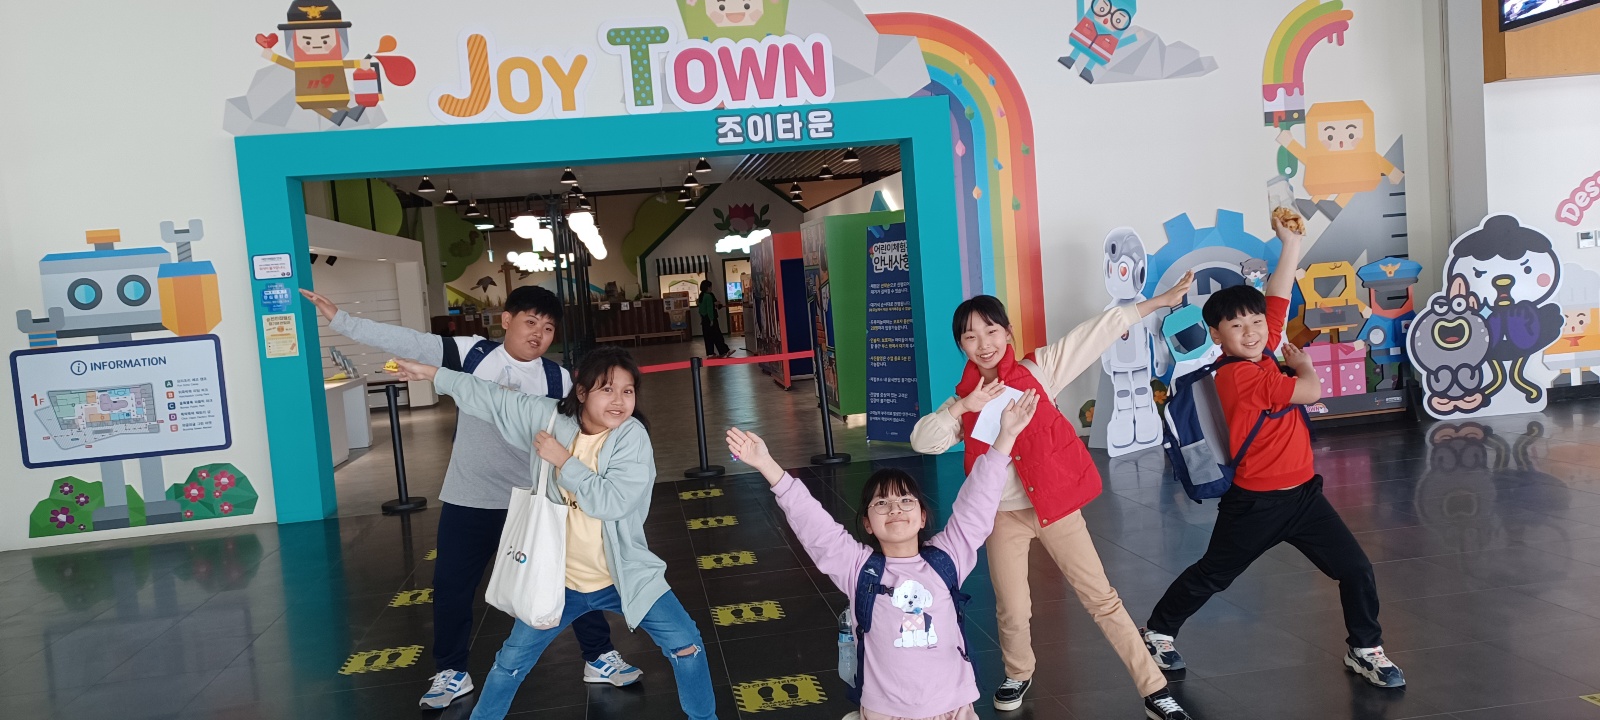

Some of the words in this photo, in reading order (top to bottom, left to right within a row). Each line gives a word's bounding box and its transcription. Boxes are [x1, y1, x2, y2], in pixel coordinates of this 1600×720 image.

[307, 73, 335, 89] 119
[437, 33, 588, 118] JOY
[606, 25, 828, 107] TOWN
[716, 109, 835, 145] 조이타운
[1561, 175, 1600, 222] Des
[873, 242, 907, 254] 어린이체험
[90, 356, 167, 371] INFORMATION
